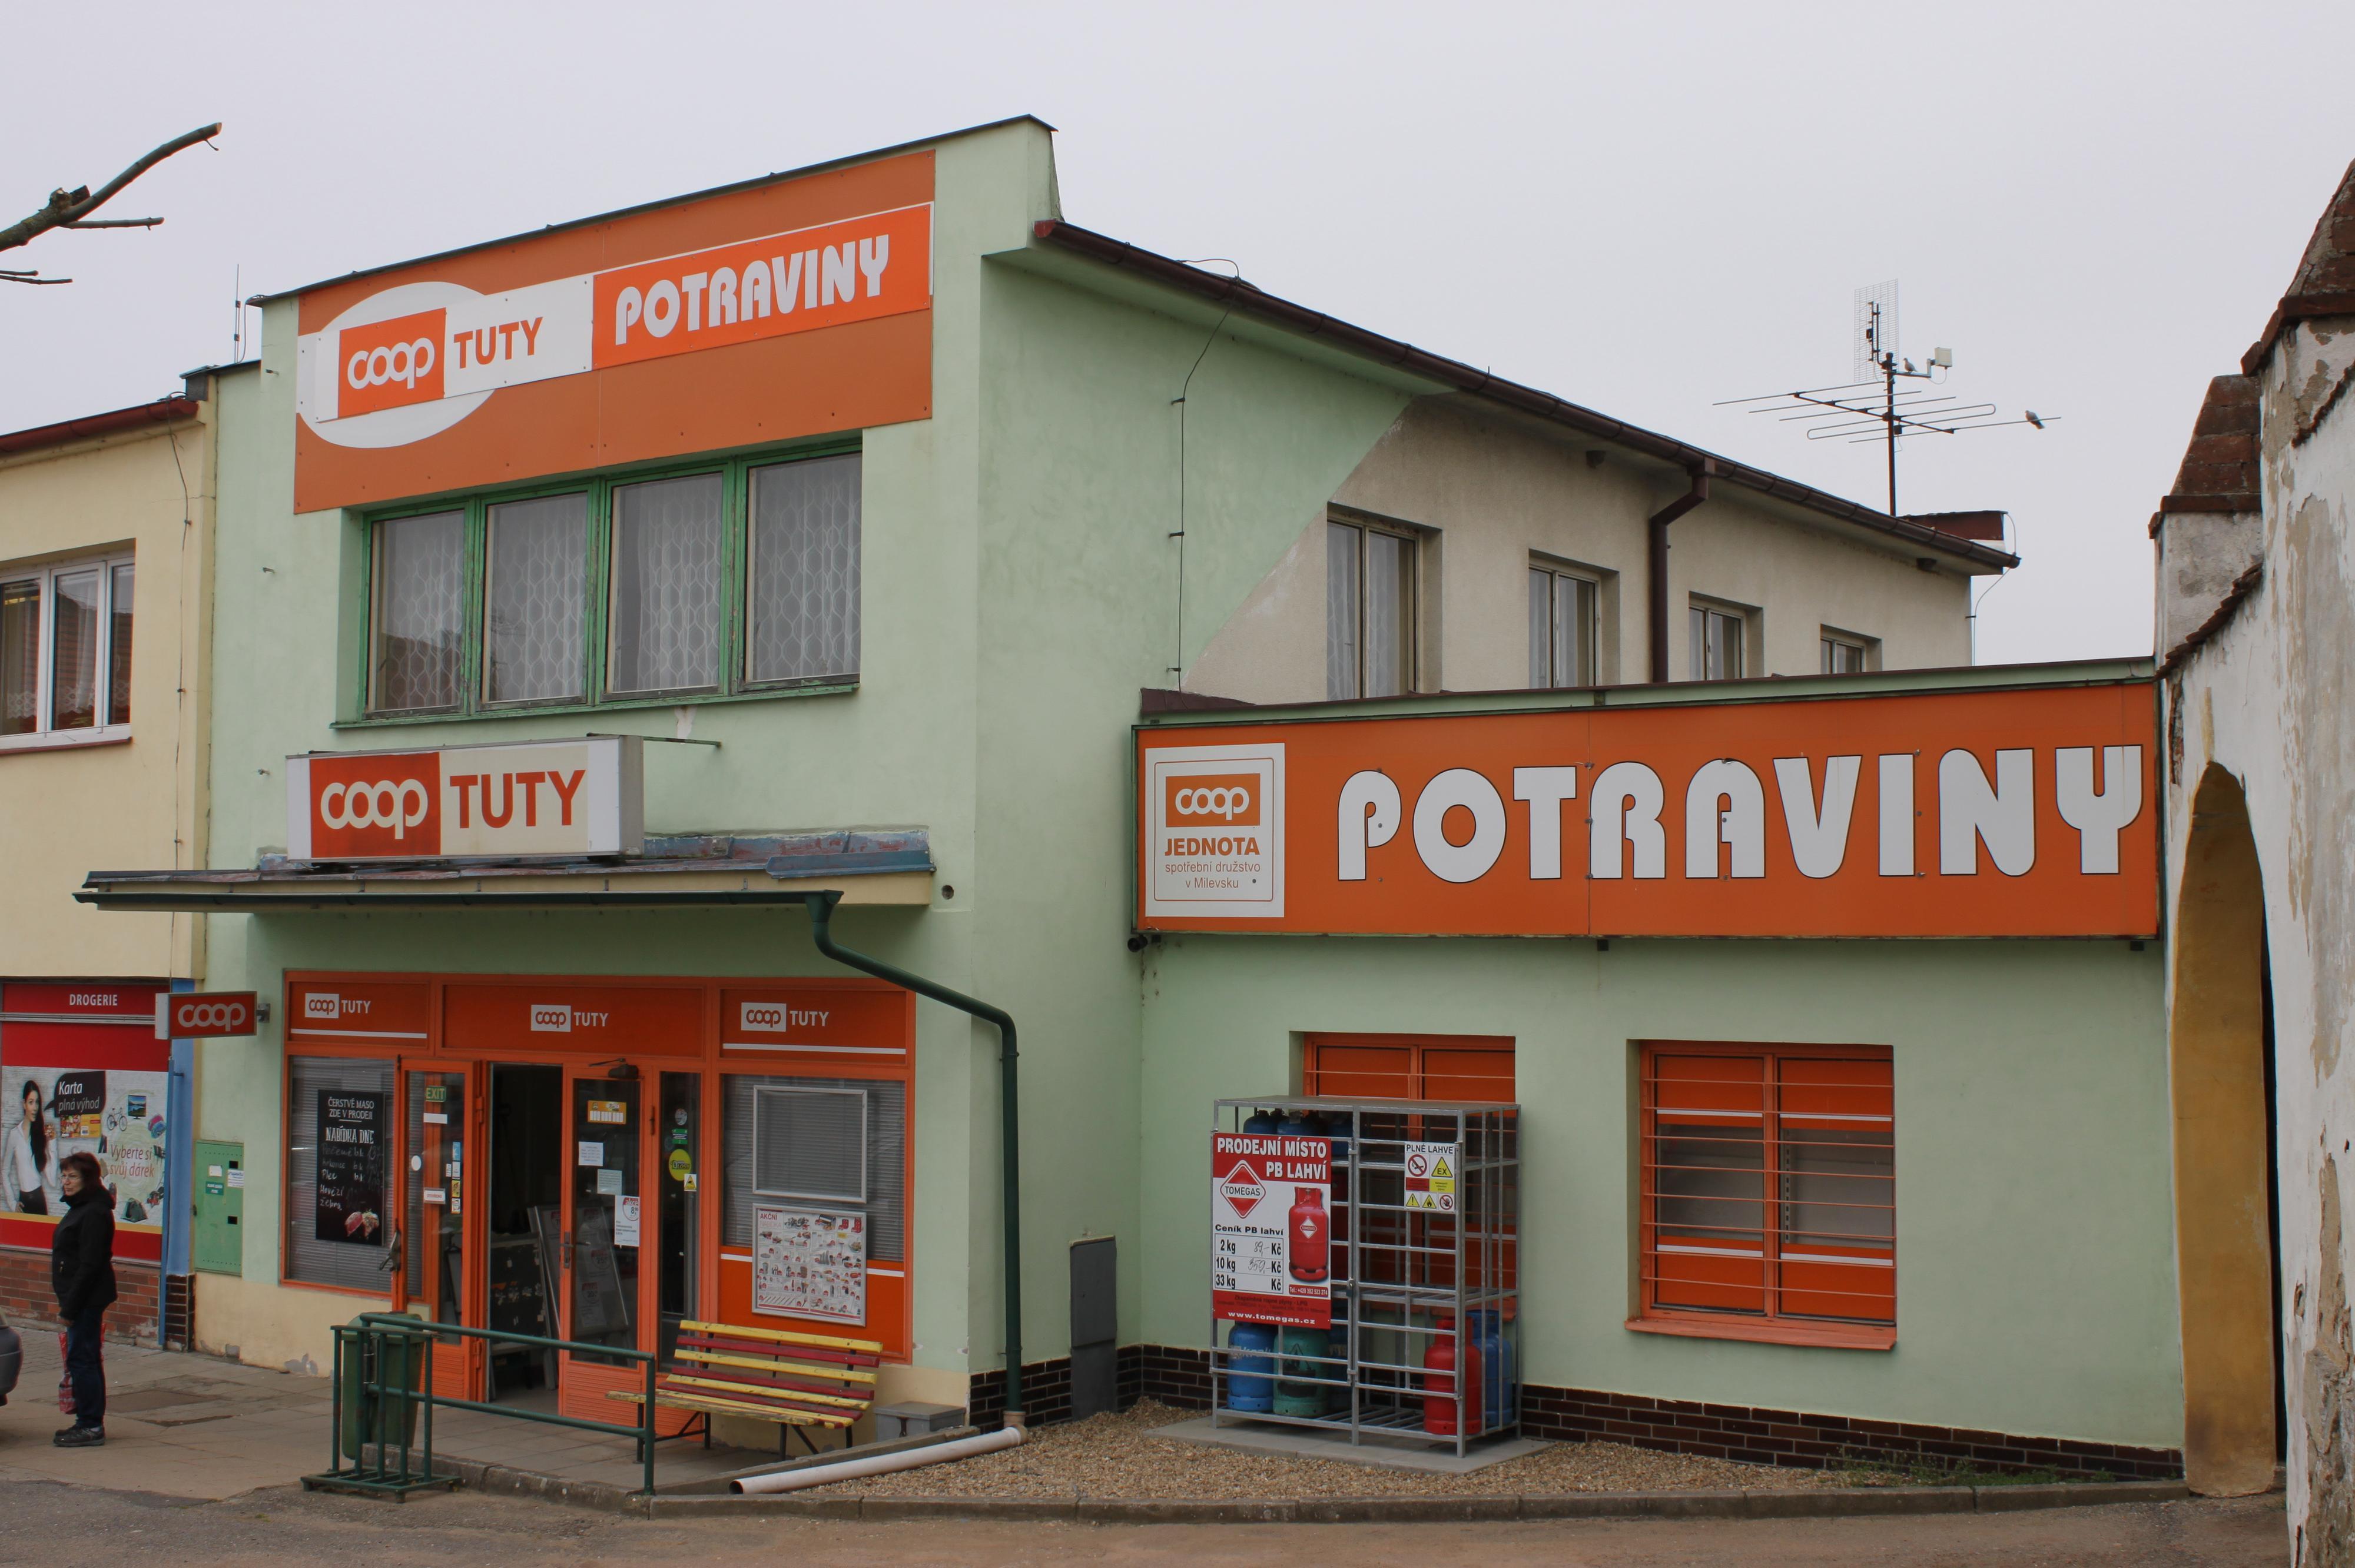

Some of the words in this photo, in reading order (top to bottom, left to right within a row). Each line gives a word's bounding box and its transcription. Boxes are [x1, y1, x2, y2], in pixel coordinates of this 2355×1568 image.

[615, 234, 890, 346] POTRAVINY
[347, 337, 435, 388] coop
[453, 317, 543, 369] TUTY
[320, 779, 428, 839] coop
[450, 769, 586, 829] TUTY
[1175, 787, 1249, 820] coop
[1338, 745, 2143, 883] POTRAVINY
[1165, 837, 1260, 856] JEDNOTA
[1165, 861, 1212, 874] spotřební
[1216, 861, 1261, 872] družstvo
[1186, 879, 1191, 888] v
[1195, 877, 1239, 888] Milevsku
[69, 994, 118, 1006] DROGERIE
[309, 999, 335, 1015] coop
[341, 1000, 371, 1014] TUTY
[178, 1003, 246, 1031] coop
[535, 1011, 566, 1028] coop
[574, 1012, 609, 1027] TUTY
[746, 1009, 781, 1028] coop
[790, 1010, 830, 1027] TUTY
[59, 1081, 82, 1095] Karta
[426, 1088, 445, 1099] EXIT
[59, 1099, 75, 1112] plná
[77, 1097, 99, 1112] výhod
[328, 1097, 355, 1109] ČERSTVÉ
[356, 1099, 374, 1109] MASO
[329, 1109, 340, 1118] ZDE
[342, 1109, 347, 1118] V
[326, 1125, 357, 1143] NABÍDKA
[359, 1129, 374, 1144] DNE
[111, 1144, 143, 1161] Vyberte
[146, 1147, 152, 1160] si
[1218, 1137, 1281, 1156] PRODEJNÍ
[1285, 1138, 1326, 1158] MÍSTO
[1406, 1143, 1426, 1152] PLNÉ
[1428, 1145, 1453, 1154] LAHVE
[110, 1160, 127, 1178] svůj
[129, 1161, 155, 1178] dárek
[1266, 1161, 1283, 1177] PB
[1287, 1159, 1327, 1180] LAHVÍ
[1225, 1185, 1261, 1197] TOMEGAS
[759, 1212, 778, 1221] AKČNÍ
[1215, 1223, 1242, 1233] Ceník
[1261, 1227, 1283, 1236] lahví
[1220, 1239, 1225, 1251] 2
[1226, 1239, 1236, 1254] kg
[1271, 1242, 1281, 1255] Kč
[1216, 1257, 1225, 1270] 10
[1226, 1257, 1236, 1272] kg
[1271, 1260, 1281, 1274] Kč
[1216, 1274, 1225, 1286] 33
[1226, 1274, 1236, 1290] kg
[1271, 1277, 1281, 1291] Kč
[1228, 1311, 1316, 1324] www.tomegas.cz
